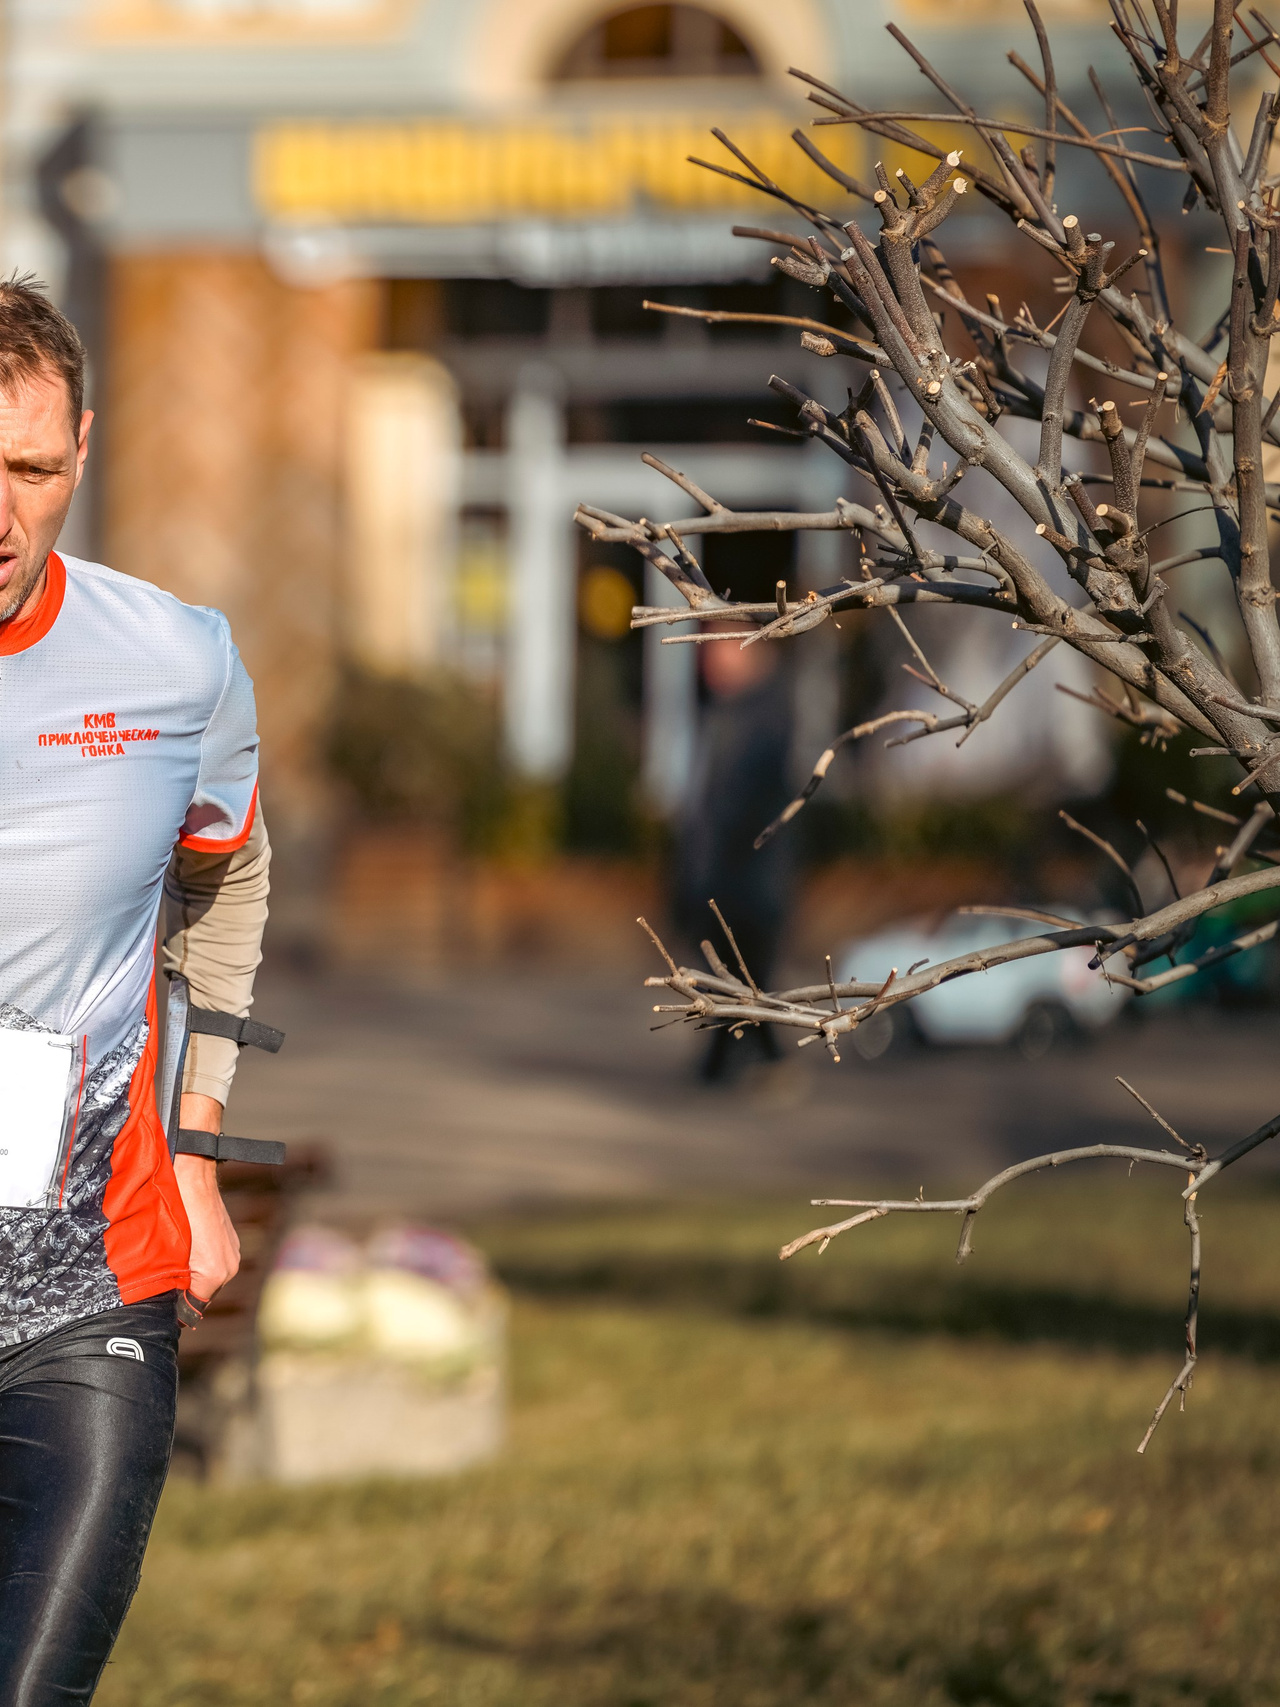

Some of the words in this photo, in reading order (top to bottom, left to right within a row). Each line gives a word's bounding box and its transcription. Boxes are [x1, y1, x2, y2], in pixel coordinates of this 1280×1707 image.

[84, 712, 116, 729] КМВ
[38, 728, 160, 747] ПРИКЛЮЧЕНЧЕСКАЯ
[81, 743, 125, 757] ГОНКА
